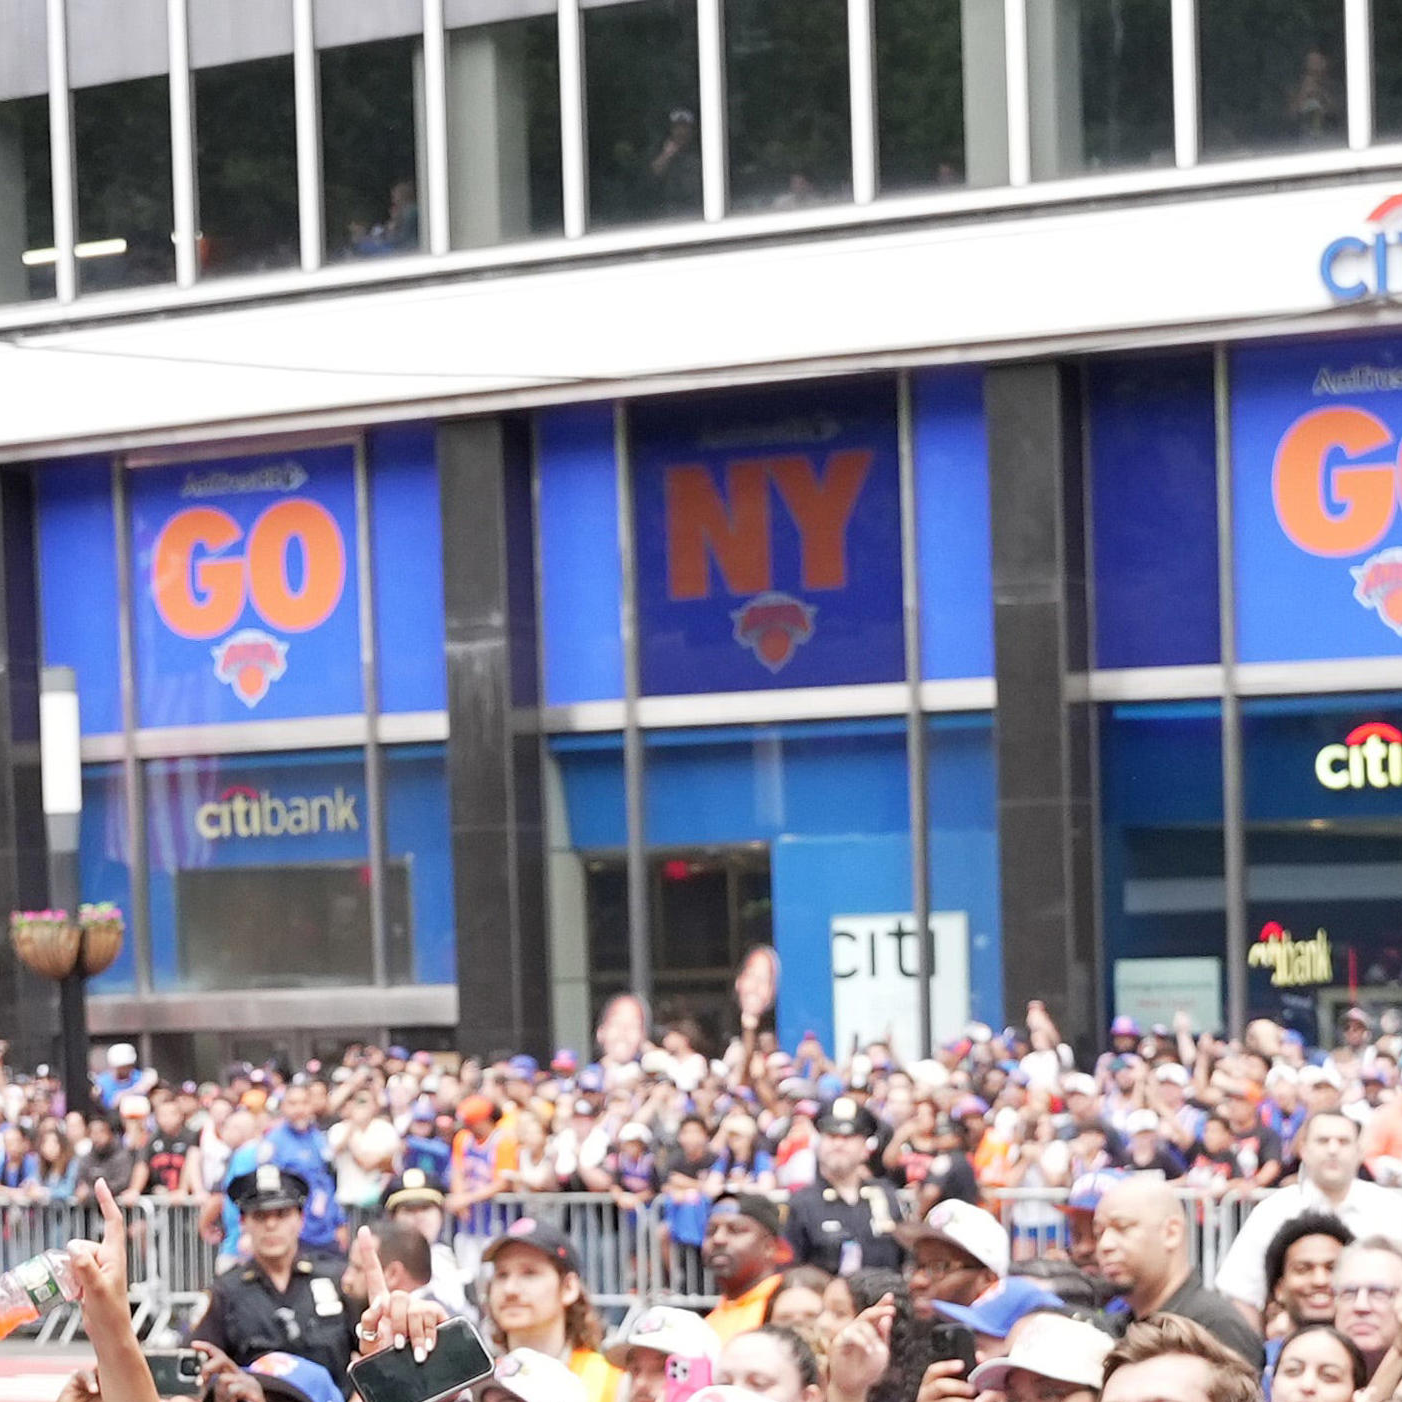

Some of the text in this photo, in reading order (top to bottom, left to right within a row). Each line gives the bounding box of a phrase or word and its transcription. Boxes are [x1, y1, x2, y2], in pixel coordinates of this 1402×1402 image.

[151, 496, 347, 641] GO
[664, 449, 874, 601] NY
[194, 786, 361, 841] citibank
